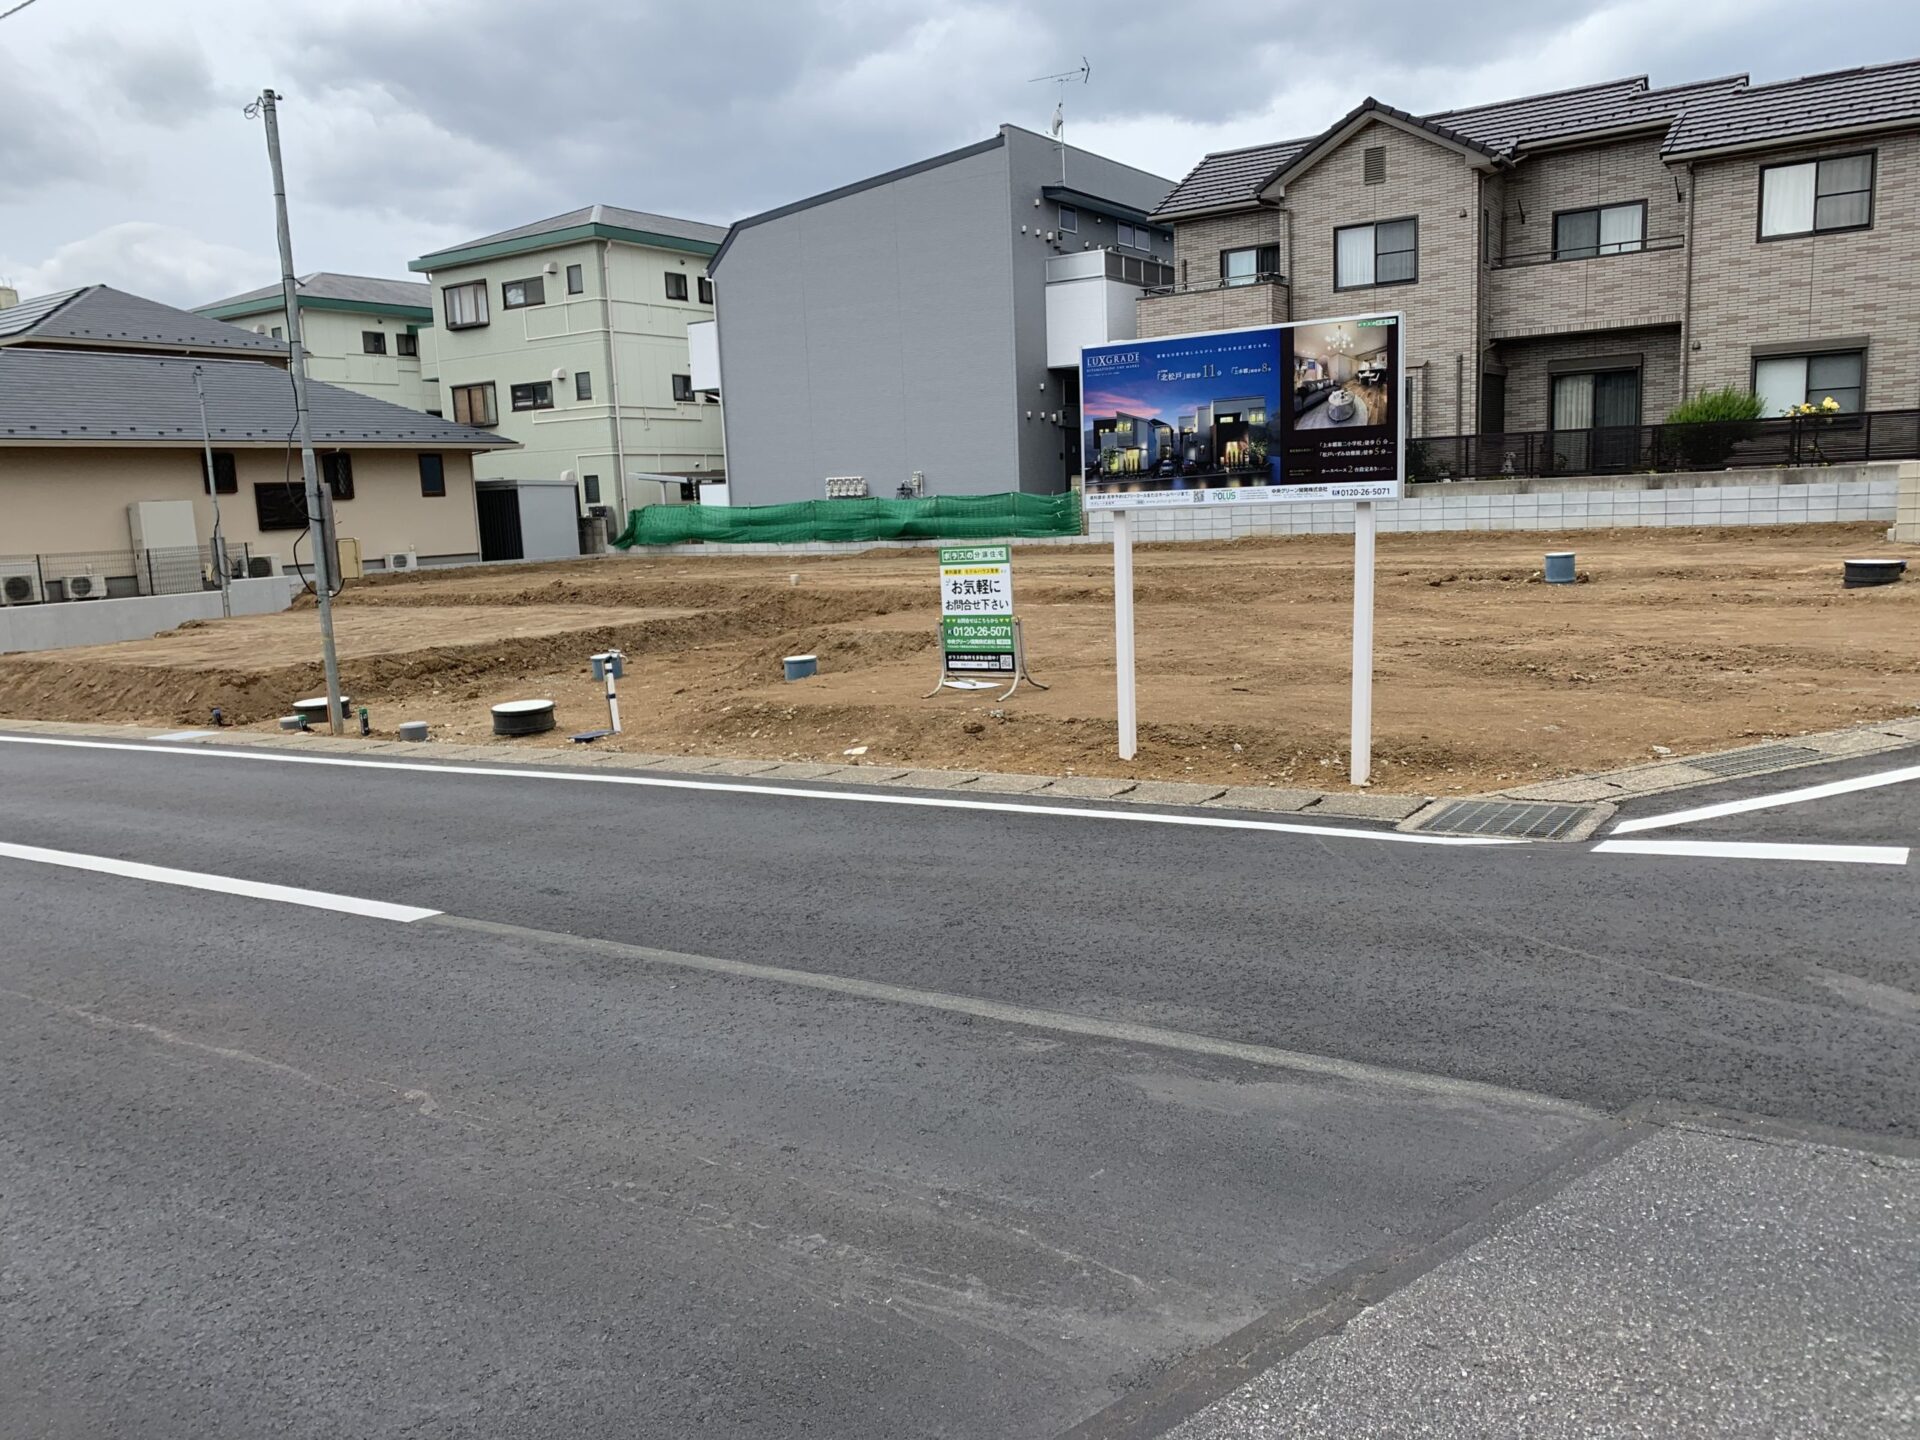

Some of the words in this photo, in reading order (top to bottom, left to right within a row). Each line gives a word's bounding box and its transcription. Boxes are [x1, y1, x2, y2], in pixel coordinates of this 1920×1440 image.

[1087, 352, 1140, 367] LUXGRADE
[1212, 491, 1236, 500] POLUS
[1341, 487, 1391, 497] 0120-26-5071
[951, 579, 1001, 595] お気軽に
[945, 599, 1009, 611] お問合せ下さい
[953, 626, 1011, 636] 0120-26-5071
